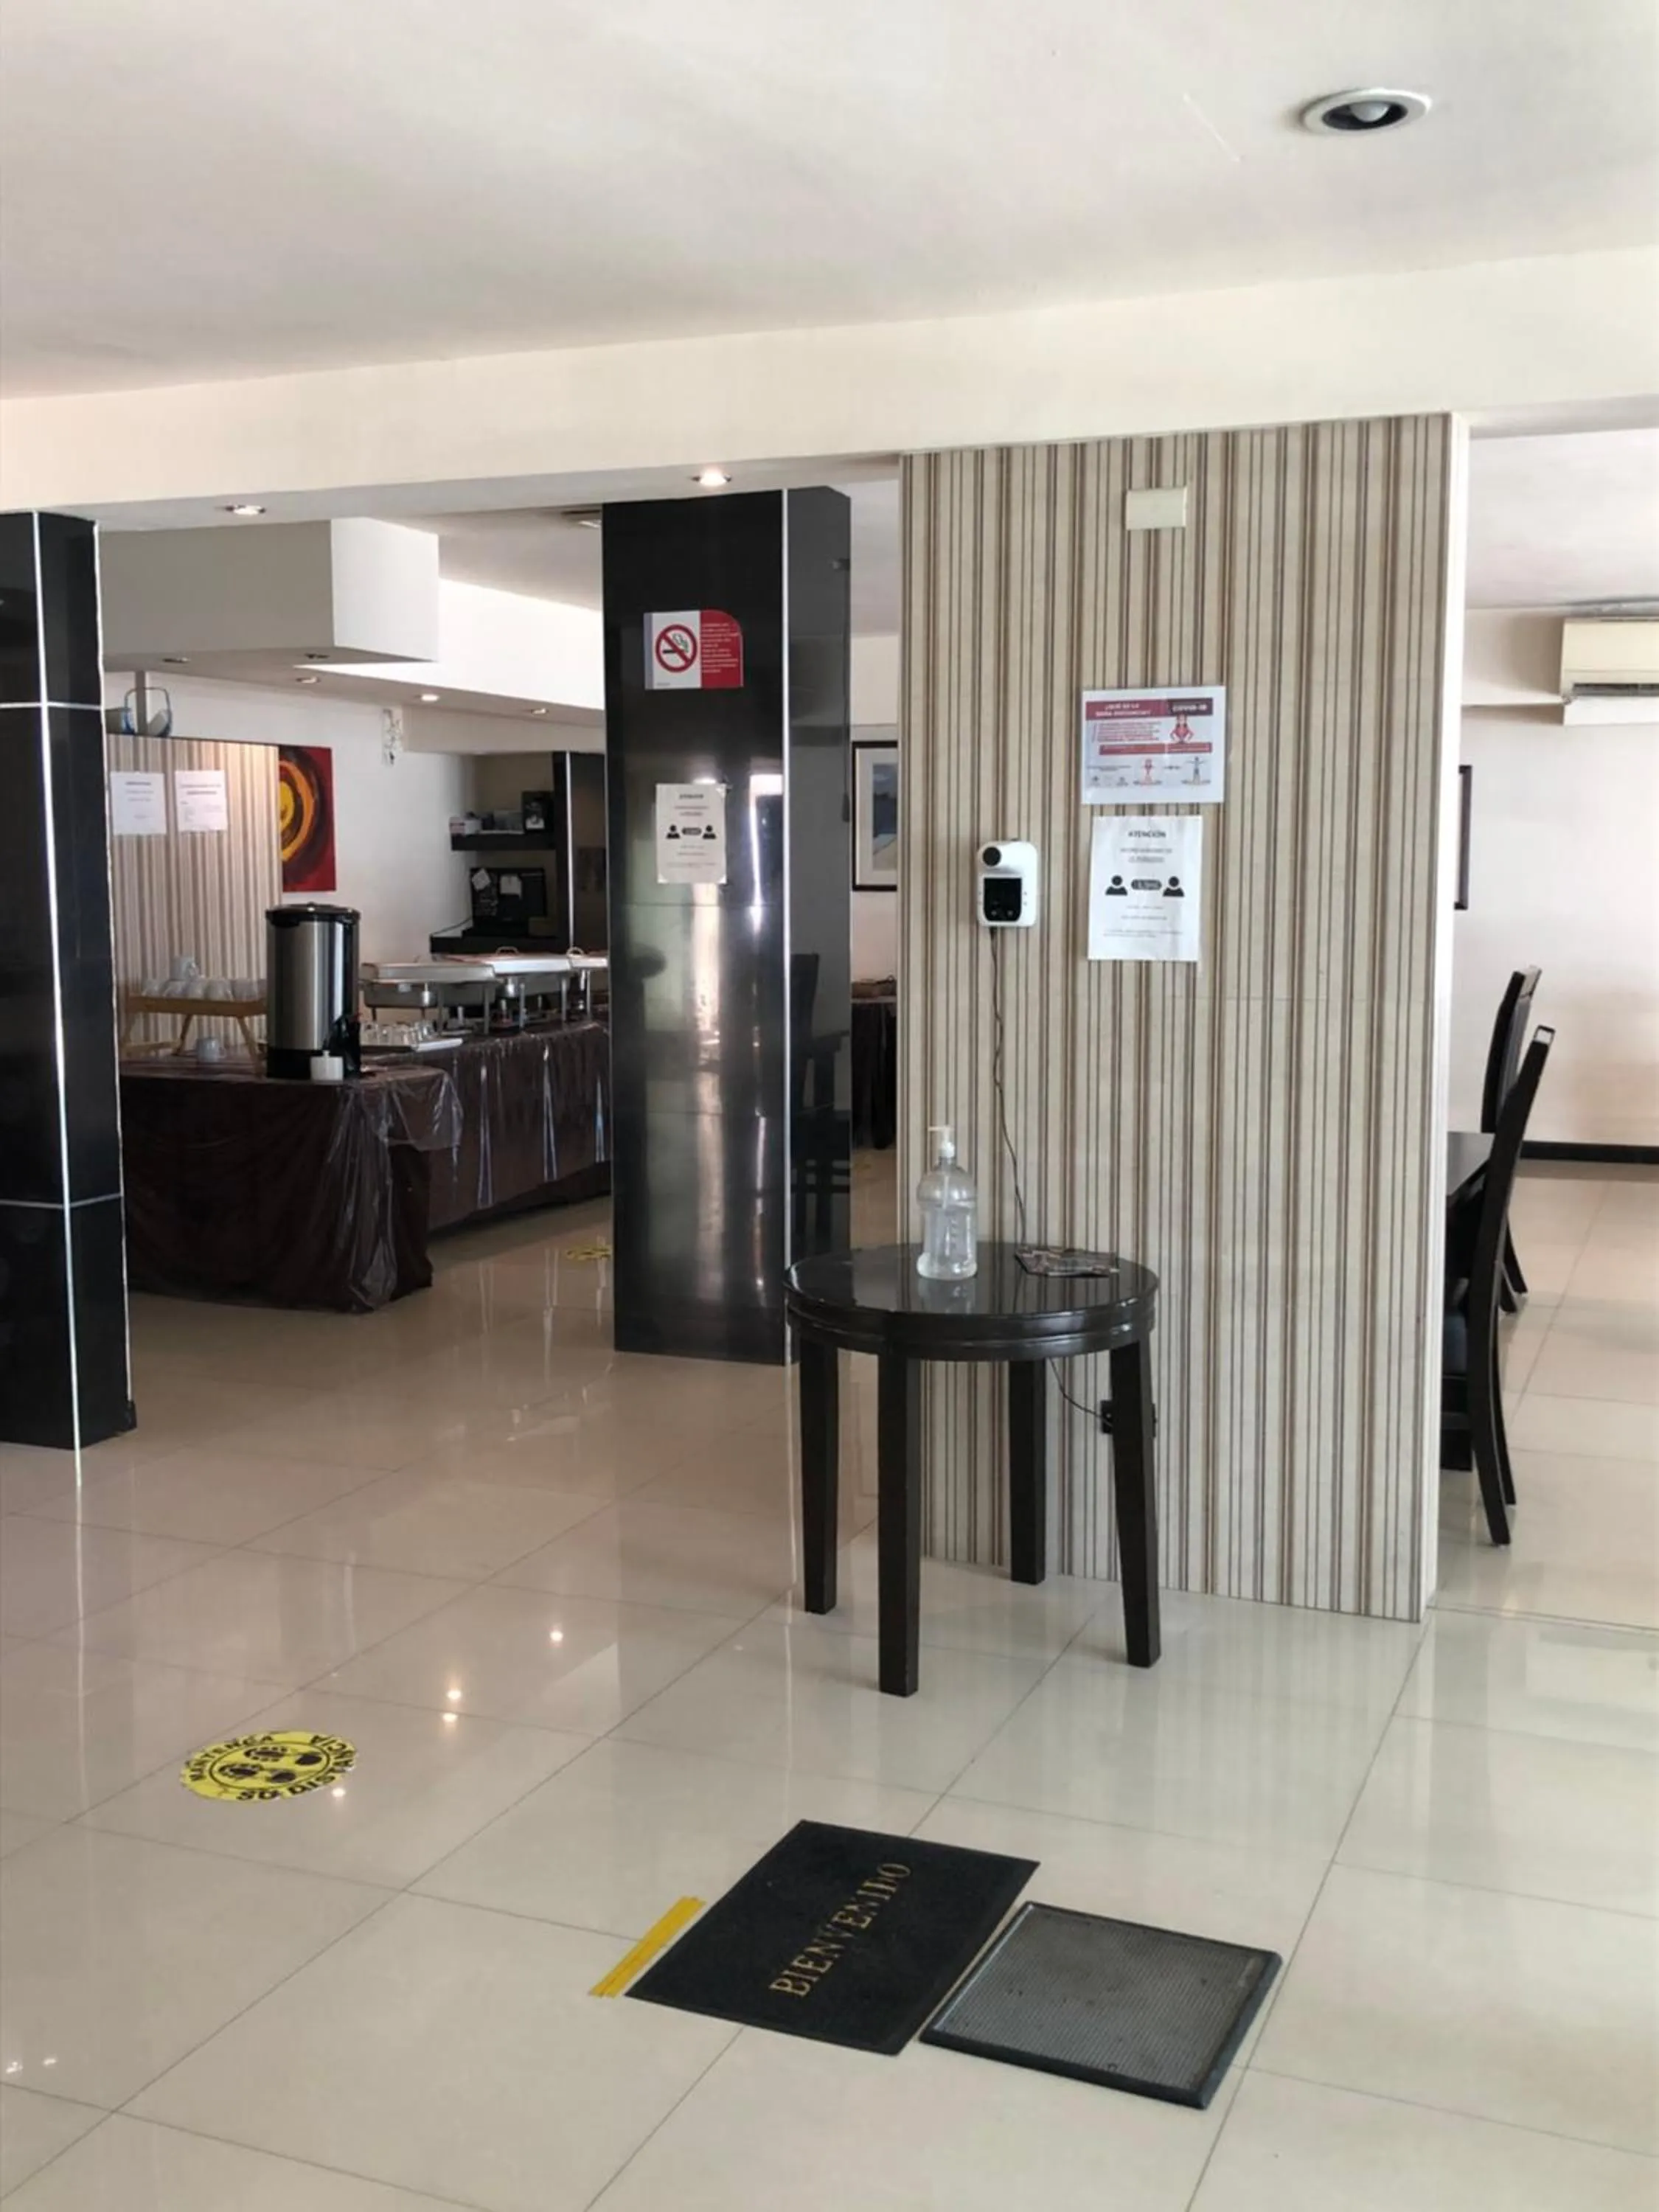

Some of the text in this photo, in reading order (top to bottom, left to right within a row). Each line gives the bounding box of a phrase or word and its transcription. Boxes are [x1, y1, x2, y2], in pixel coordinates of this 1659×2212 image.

[185, 1735, 274, 1782] MANTENGA
[236, 1734, 355, 1801] SU DISTANCIA
[768, 1863, 911, 1997] BIENVENIDO
